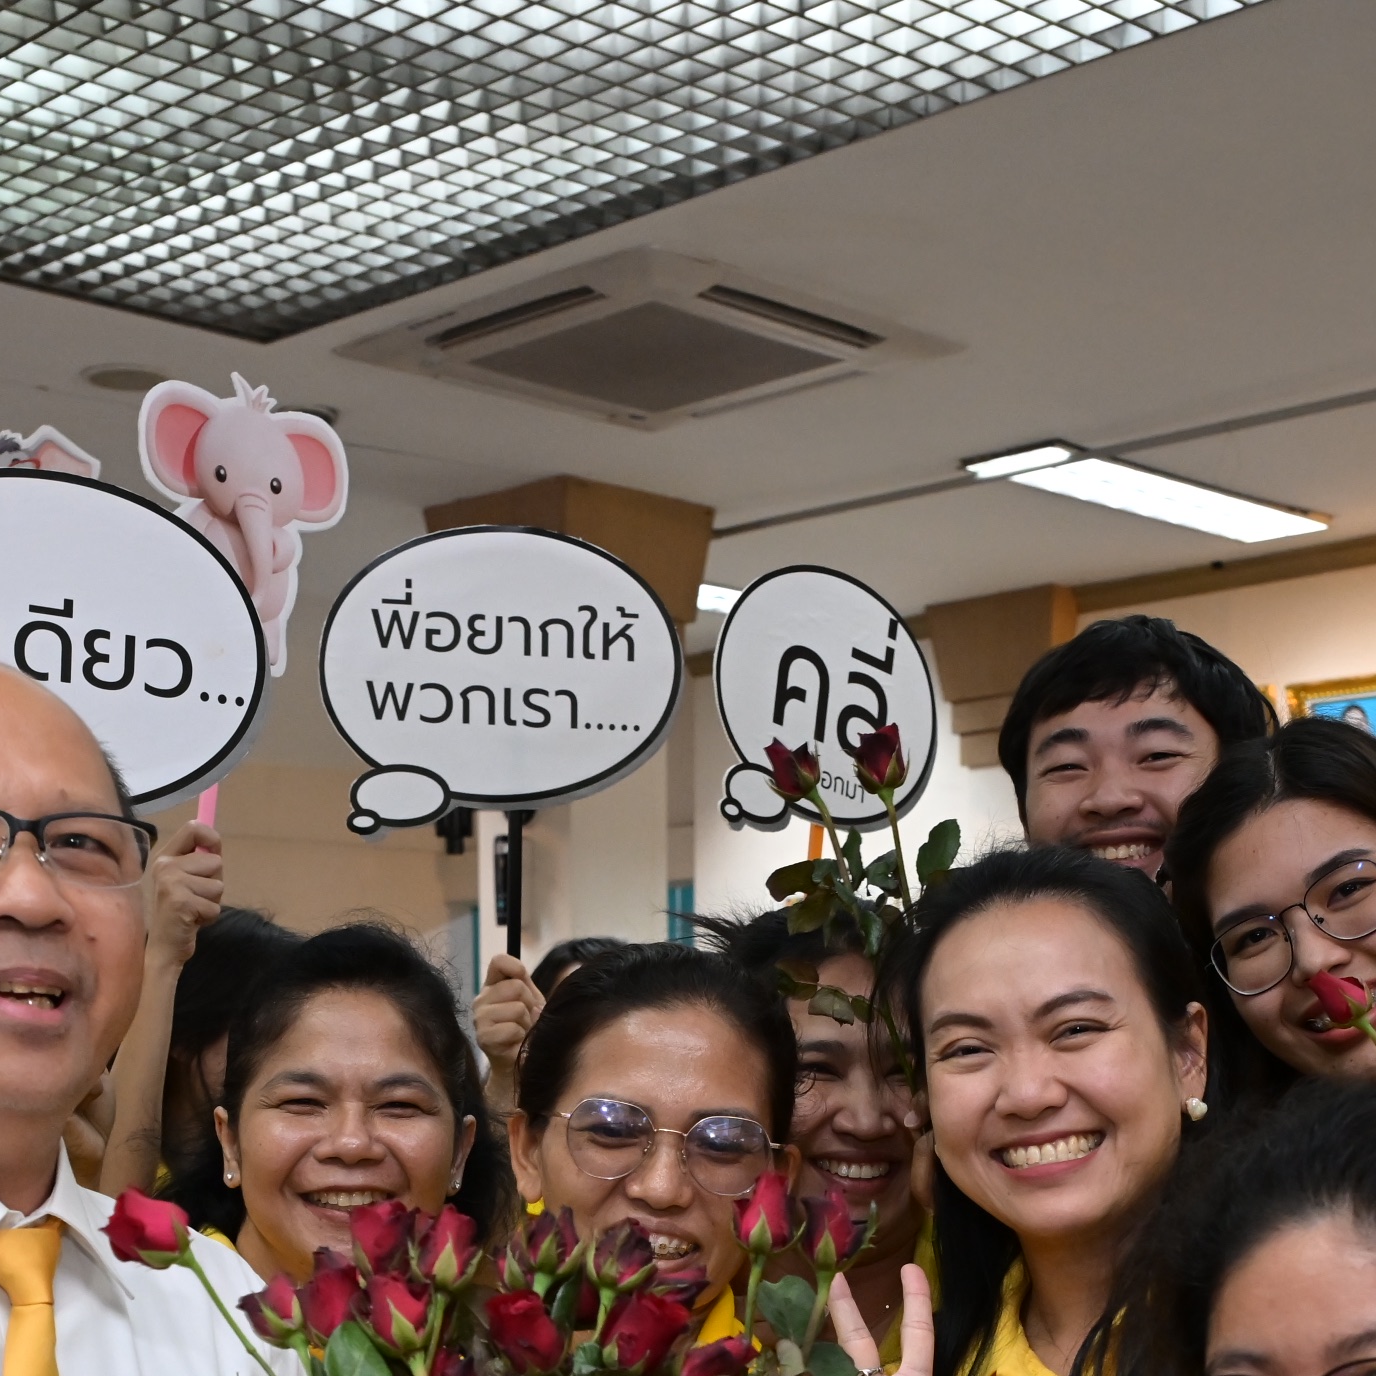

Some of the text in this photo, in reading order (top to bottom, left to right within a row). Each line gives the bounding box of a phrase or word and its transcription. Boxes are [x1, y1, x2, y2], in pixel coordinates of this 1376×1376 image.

[371, 578, 639, 662] พี่อยากให้
[772, 618, 899, 758] คลี่
